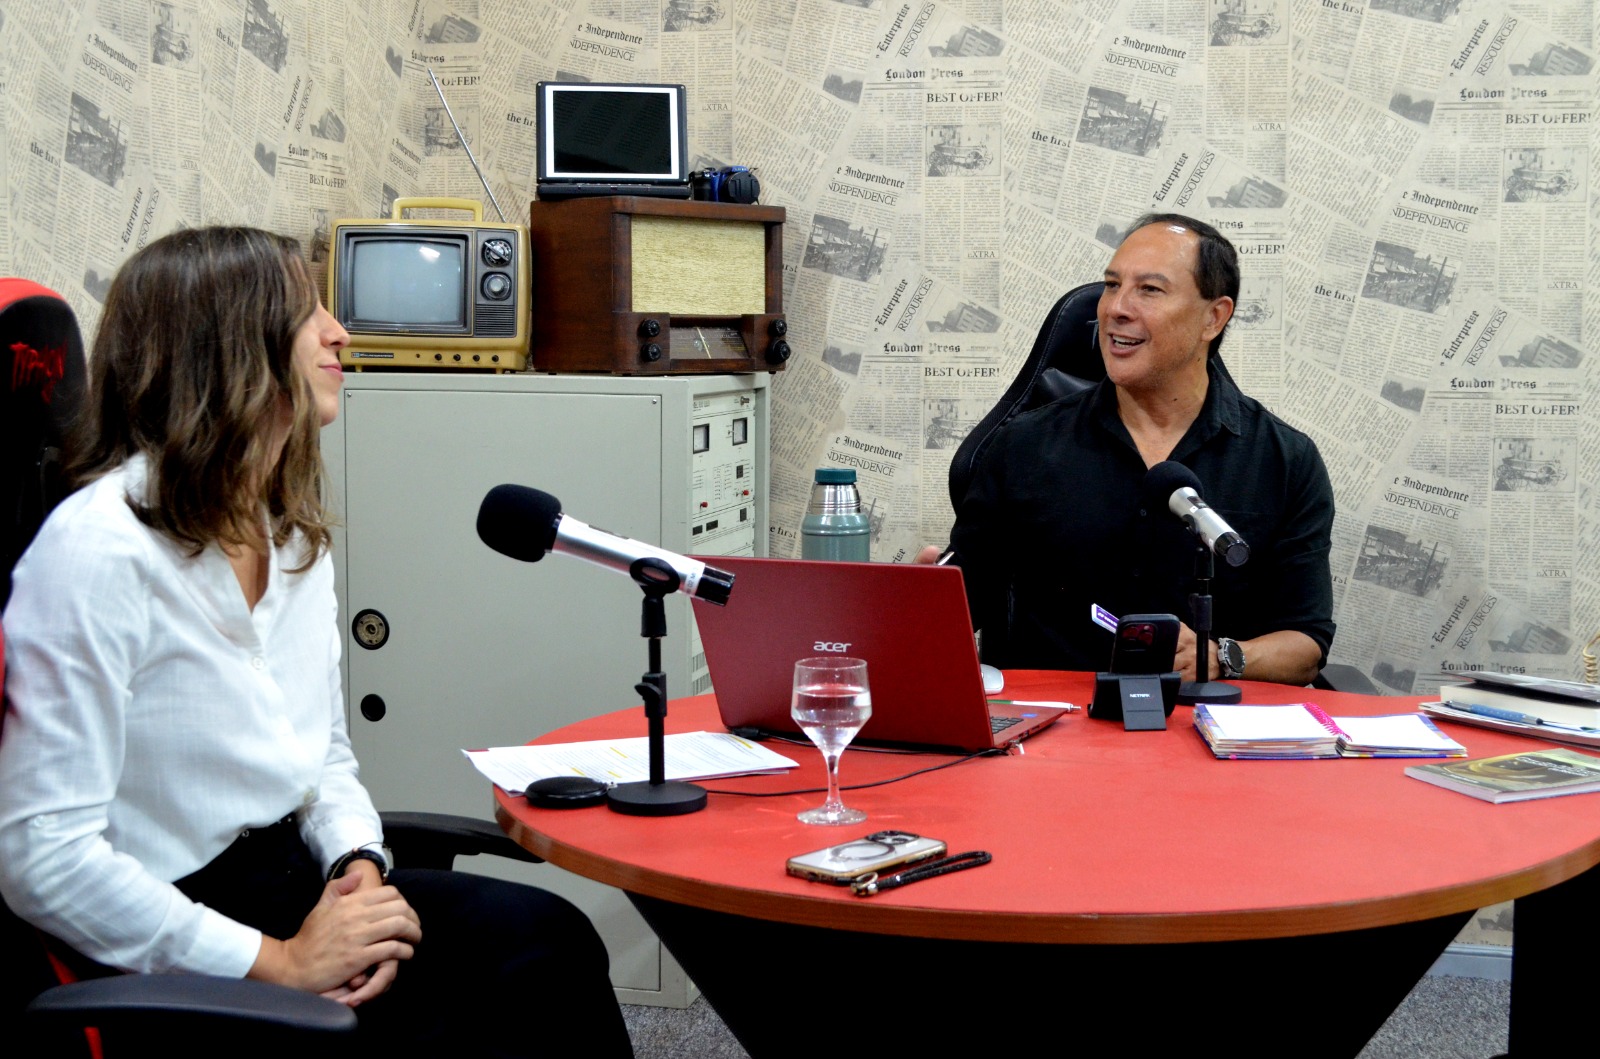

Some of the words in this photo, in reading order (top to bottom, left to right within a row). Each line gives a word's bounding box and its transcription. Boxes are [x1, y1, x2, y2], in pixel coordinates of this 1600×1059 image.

[1323, 0, 1339, 10] the
[1342, 2, 1364, 15] first
[216, 27, 226, 41] the
[585, 23, 643, 44] Independence
[877, 4, 910, 51] Enterprise
[900, 3, 936, 57] RESOURCES
[93, 34, 138, 73] Independence
[1122, 36, 1187, 59] Independence
[1452, 18, 1489, 70] Enterprise
[1479, 17, 1518, 76] RESOURCES
[443, 76, 481, 86] OFFER!
[885, 69, 926, 81] London
[931, 68, 964, 80] Press
[927, 92, 955, 103] BEST
[959, 92, 1003, 102] OFFER!
[1460, 87, 1504, 100] London
[1512, 87, 1547, 97] Press
[507, 112, 520, 124] the
[1506, 114, 1536, 124] BEST
[1543, 113, 1591, 124] OFFER!
[1032, 131, 1048, 142] the
[1051, 135, 1071, 148] first
[31, 142, 43, 158] the
[45, 148, 61, 168] first
[311, 147, 328, 160] Press
[310, 173, 324, 186] BEST
[326, 175, 347, 189] OFFER!
[845, 165, 905, 189] Independence
[1153, 152, 1188, 202] Enterprise
[1177, 151, 1215, 208] RESOURCES
[1412, 190, 1479, 215] Independence
[121, 188, 143, 244] Enterprise
[138, 188, 160, 250] RESOURCES
[1239, 244, 1285, 255] OFFER!
[875, 278, 908, 325] Enterprise
[898, 277, 934, 331] RESOURCES
[1315, 284, 1331, 298] the
[1334, 289, 1356, 303] first
[1442, 310, 1479, 359] Enterprise
[1468, 309, 1508, 366] RESOURCES
[884, 343, 923, 354] London
[929, 343, 960, 353] Press
[924, 367, 954, 377] BEST
[957, 367, 1000, 377] OFFER!
[1450, 377, 1494, 390] London
[1501, 378, 1536, 389] Press
[1496, 404, 1528, 415] BEST
[1532, 404, 1580, 415] OFFER!
[843, 436, 903, 460] Independence
[1402, 476, 1469, 502] Independence
[778, 526, 796, 538] first
[1432, 595, 1469, 642] Enterprise
[1456, 595, 1497, 650] RESOURCES
[813, 640, 852, 652] acer
[1441, 660, 1484, 671] London
[1491, 662, 1526, 673] Press
